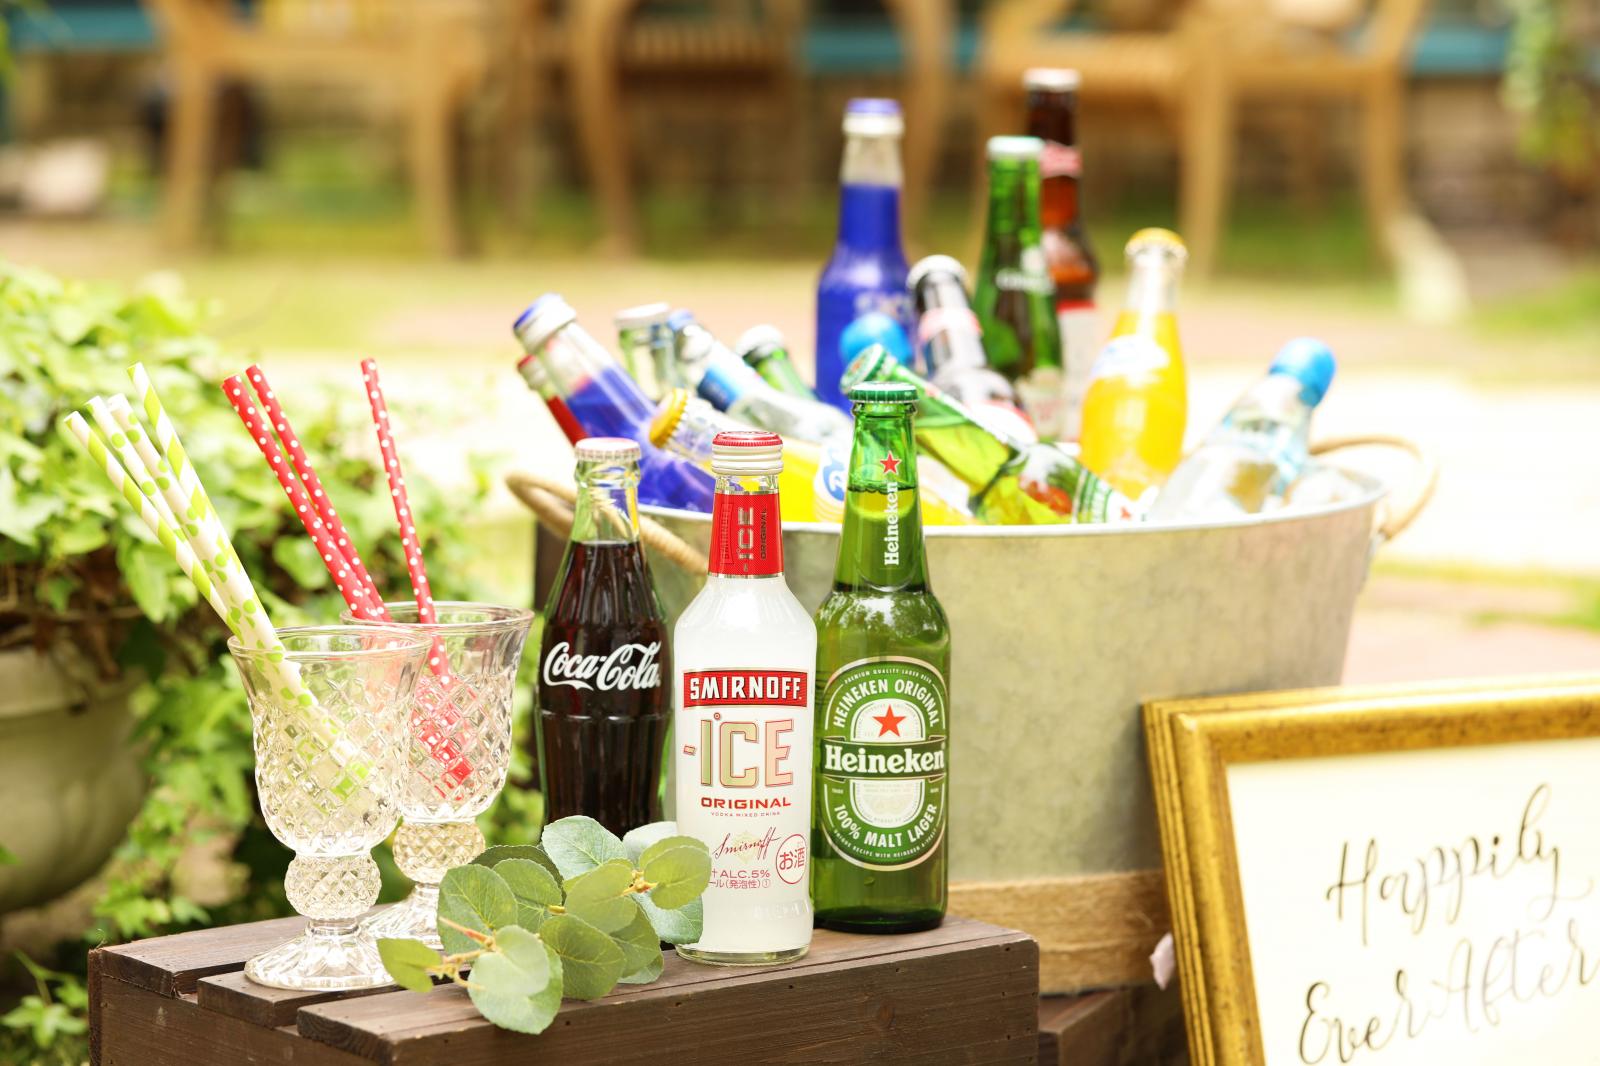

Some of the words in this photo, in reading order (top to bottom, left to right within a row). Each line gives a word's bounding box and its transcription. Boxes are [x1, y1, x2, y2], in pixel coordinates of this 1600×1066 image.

[738, 507, 754, 560] ICE
[884, 482, 899, 566] Heineken
[543, 641, 661, 692] Coca-Cola
[689, 675, 802, 700] SMIRNOFF
[833, 679, 888, 728] HEINEKEN
[895, 679, 939, 728] ORIGINAL
[825, 744, 944, 774] Heineken
[701, 797, 791, 810] ORIGINAL
[834, 804, 862, 840] 100%
[864, 831, 902, 848] MALT
[907, 804, 938, 843] LAGER
[720, 869, 771, 879] ALC.5%
[779, 846, 806, 871] お酒
[1326, 783, 1592, 947] Happily
[1299, 968, 1437, 1065] Ever
[1430, 917, 1600, 1034] After
